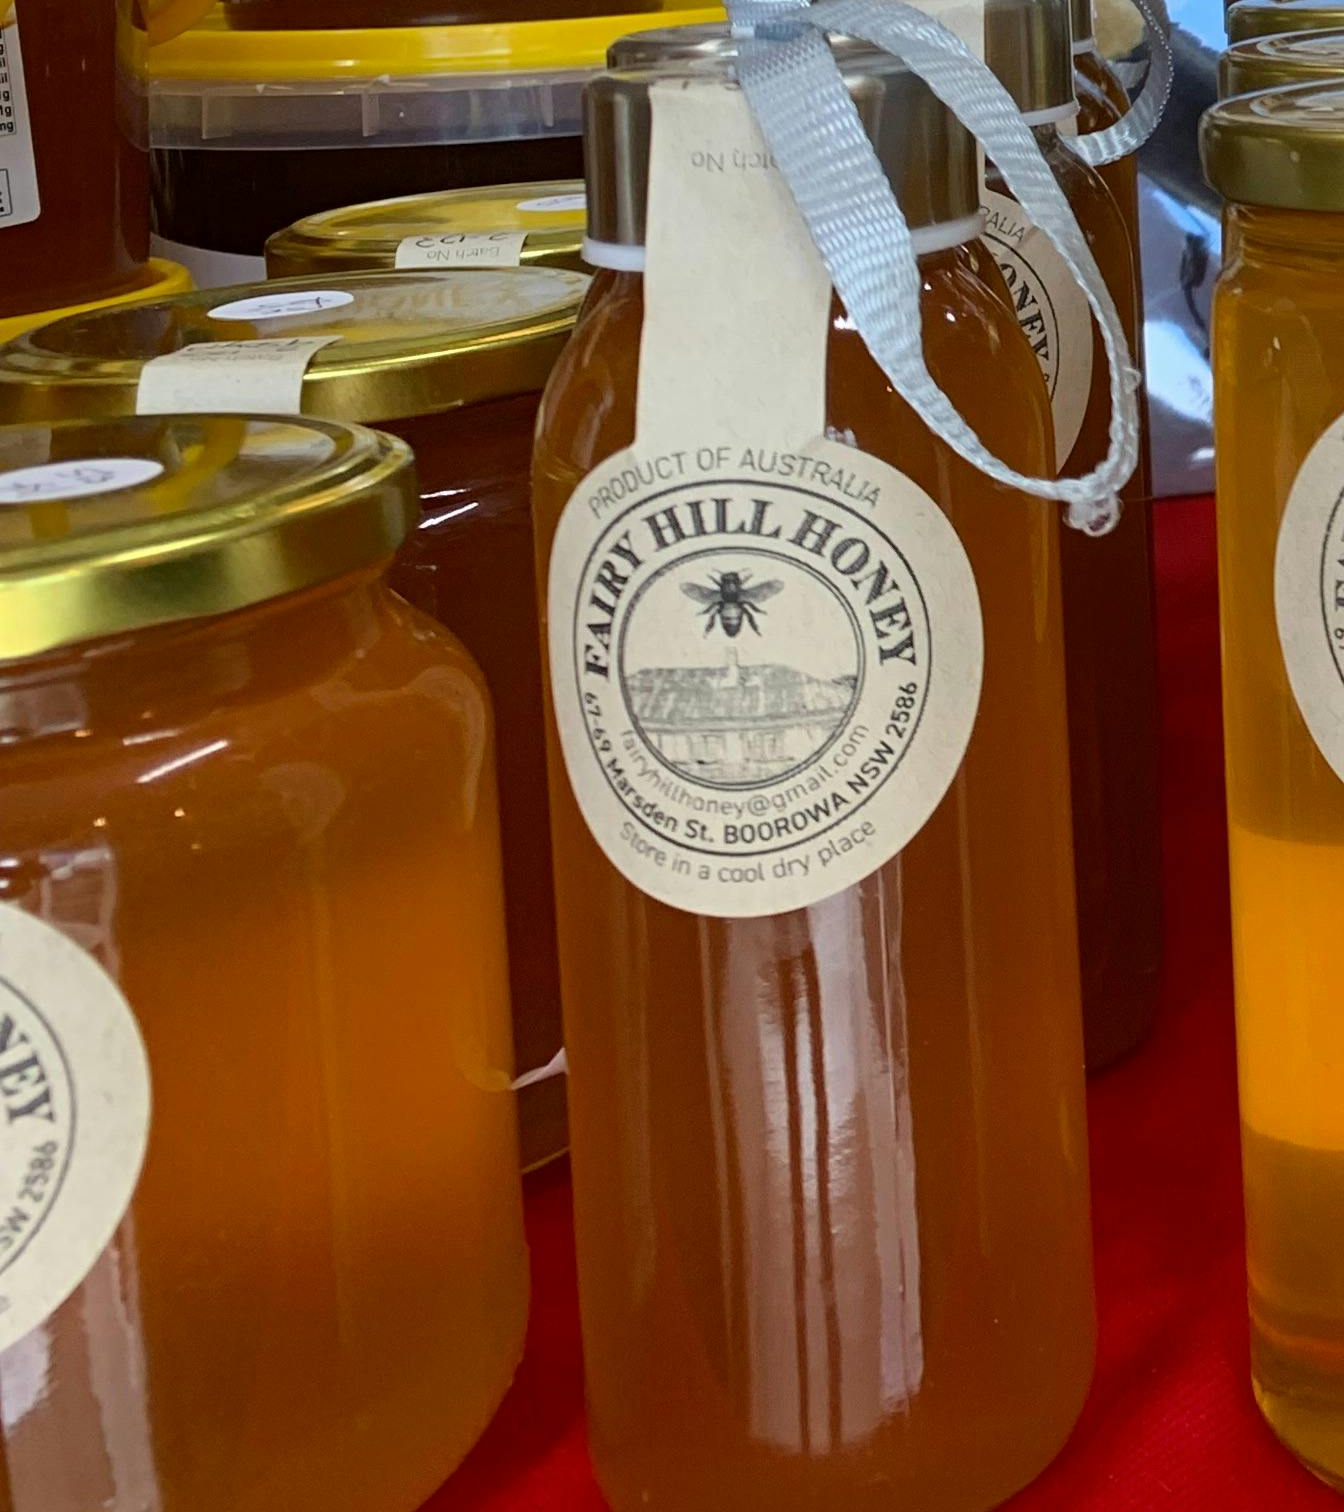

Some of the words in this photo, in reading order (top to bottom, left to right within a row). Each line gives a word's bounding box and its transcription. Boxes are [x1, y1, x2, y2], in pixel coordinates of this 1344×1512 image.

[587, 452, 688, 518] PRODUCT
[697, 447, 731, 472] OF
[740, 448, 881, 508] AUSTRALIA
[584, 533, 648, 680] FAIRY
[642, 497, 782, 552] HILL
[787, 510, 918, 668] HONEY
[583, 691, 612, 758] 67-69
[605, 757, 679, 834] Marsden
[685, 818, 715, 844] St.
[723, 792, 849, 846] BOOROWA
[850, 742, 895, 795] NSW
[886, 681, 919, 739] 2586
[619, 728, 870, 819] fairyhillhoney@gmail.com
[619, 820, 668, 870] Store
[672, 854, 692, 877] in
[697, 863, 711, 882] a
[717, 860, 765, 884] cool
[772, 848, 811, 880] dry
[817, 818, 877, 870] place
[0, 1013, 55, 1125] NEY
[18, 1141, 58, 1204] 2586
